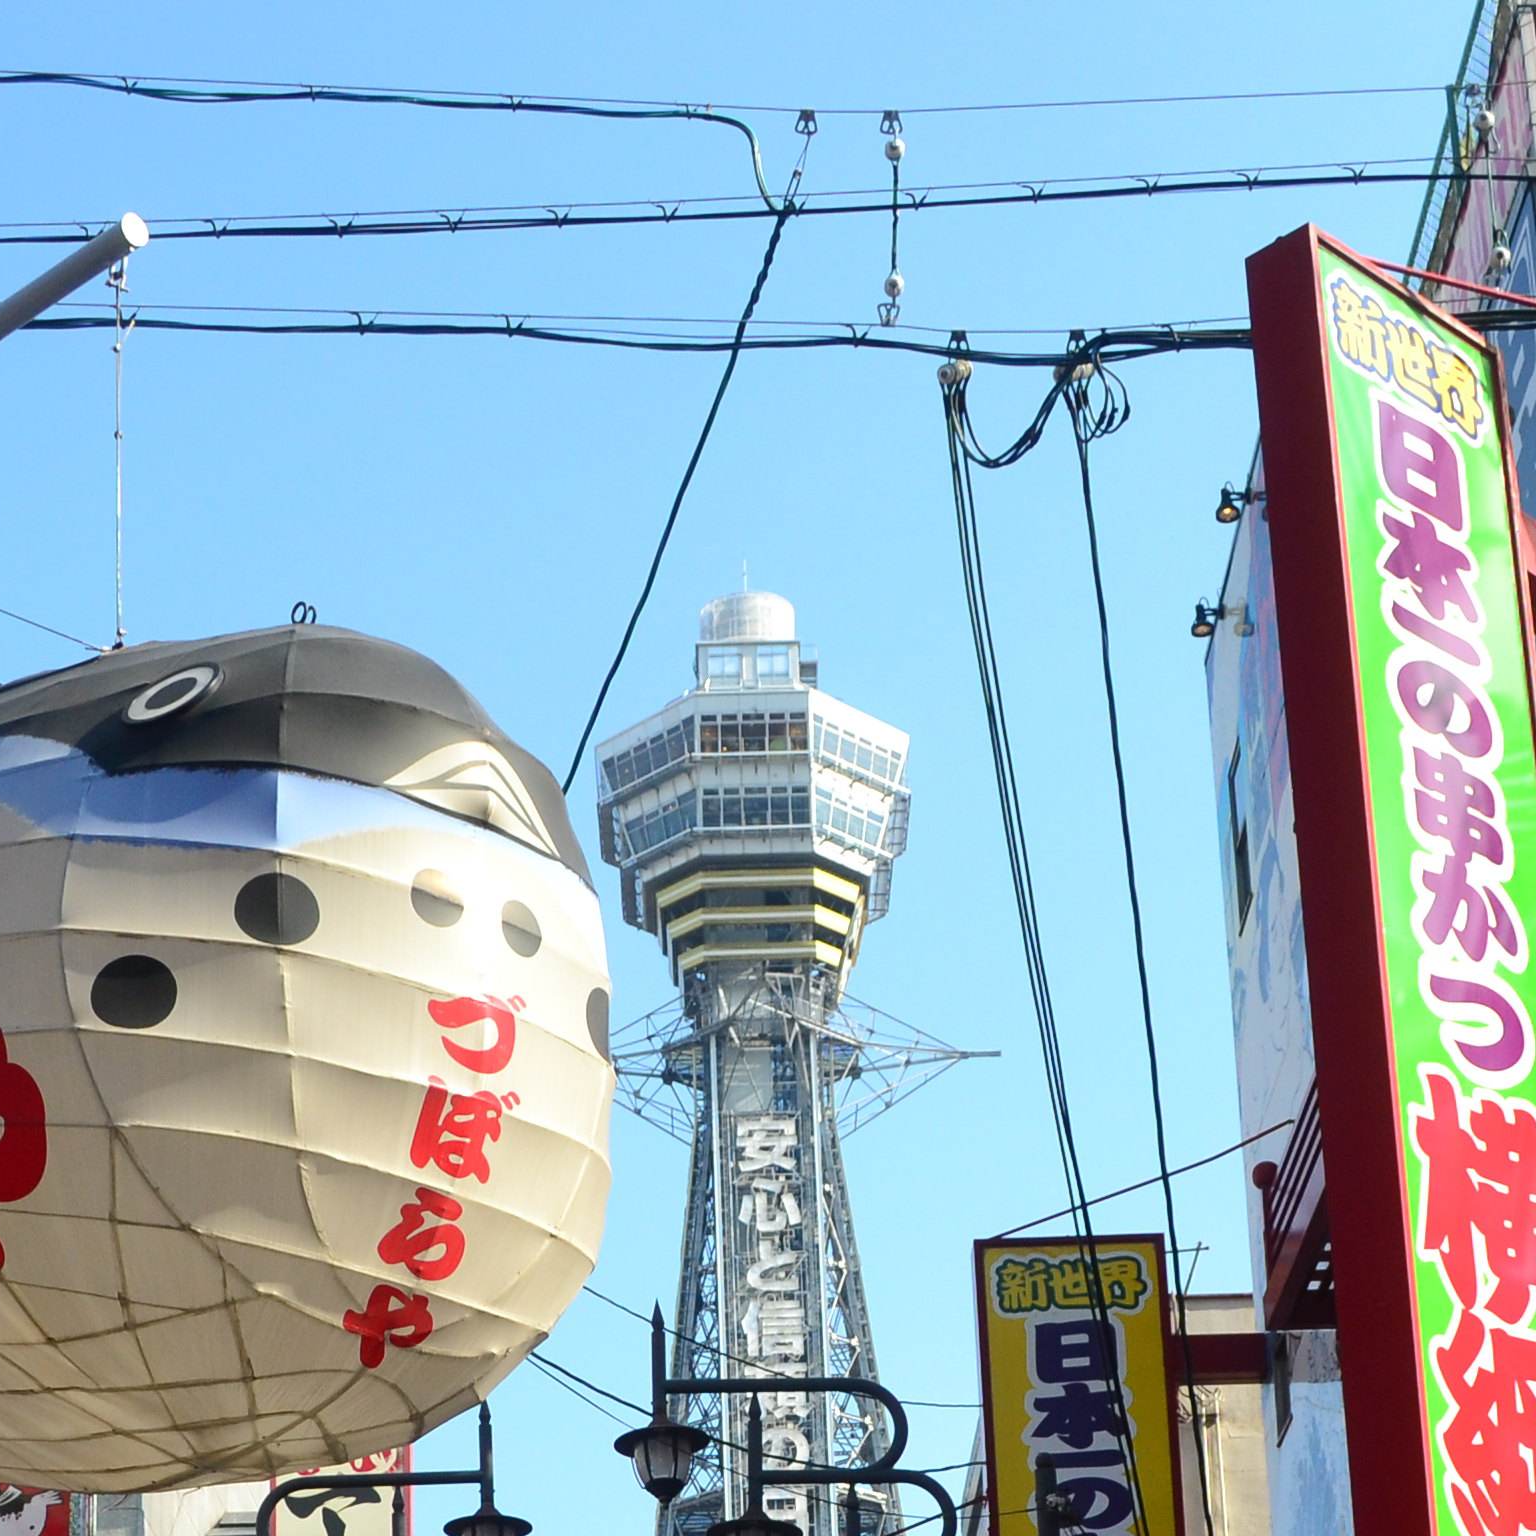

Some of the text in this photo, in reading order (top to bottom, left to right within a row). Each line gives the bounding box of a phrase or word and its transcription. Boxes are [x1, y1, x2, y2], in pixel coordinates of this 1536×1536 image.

[1332, 276, 1486, 440] 新世界
[341, 992, 525, 1369] づぼらや
[995, 1257, 1148, 1313] 新世界
